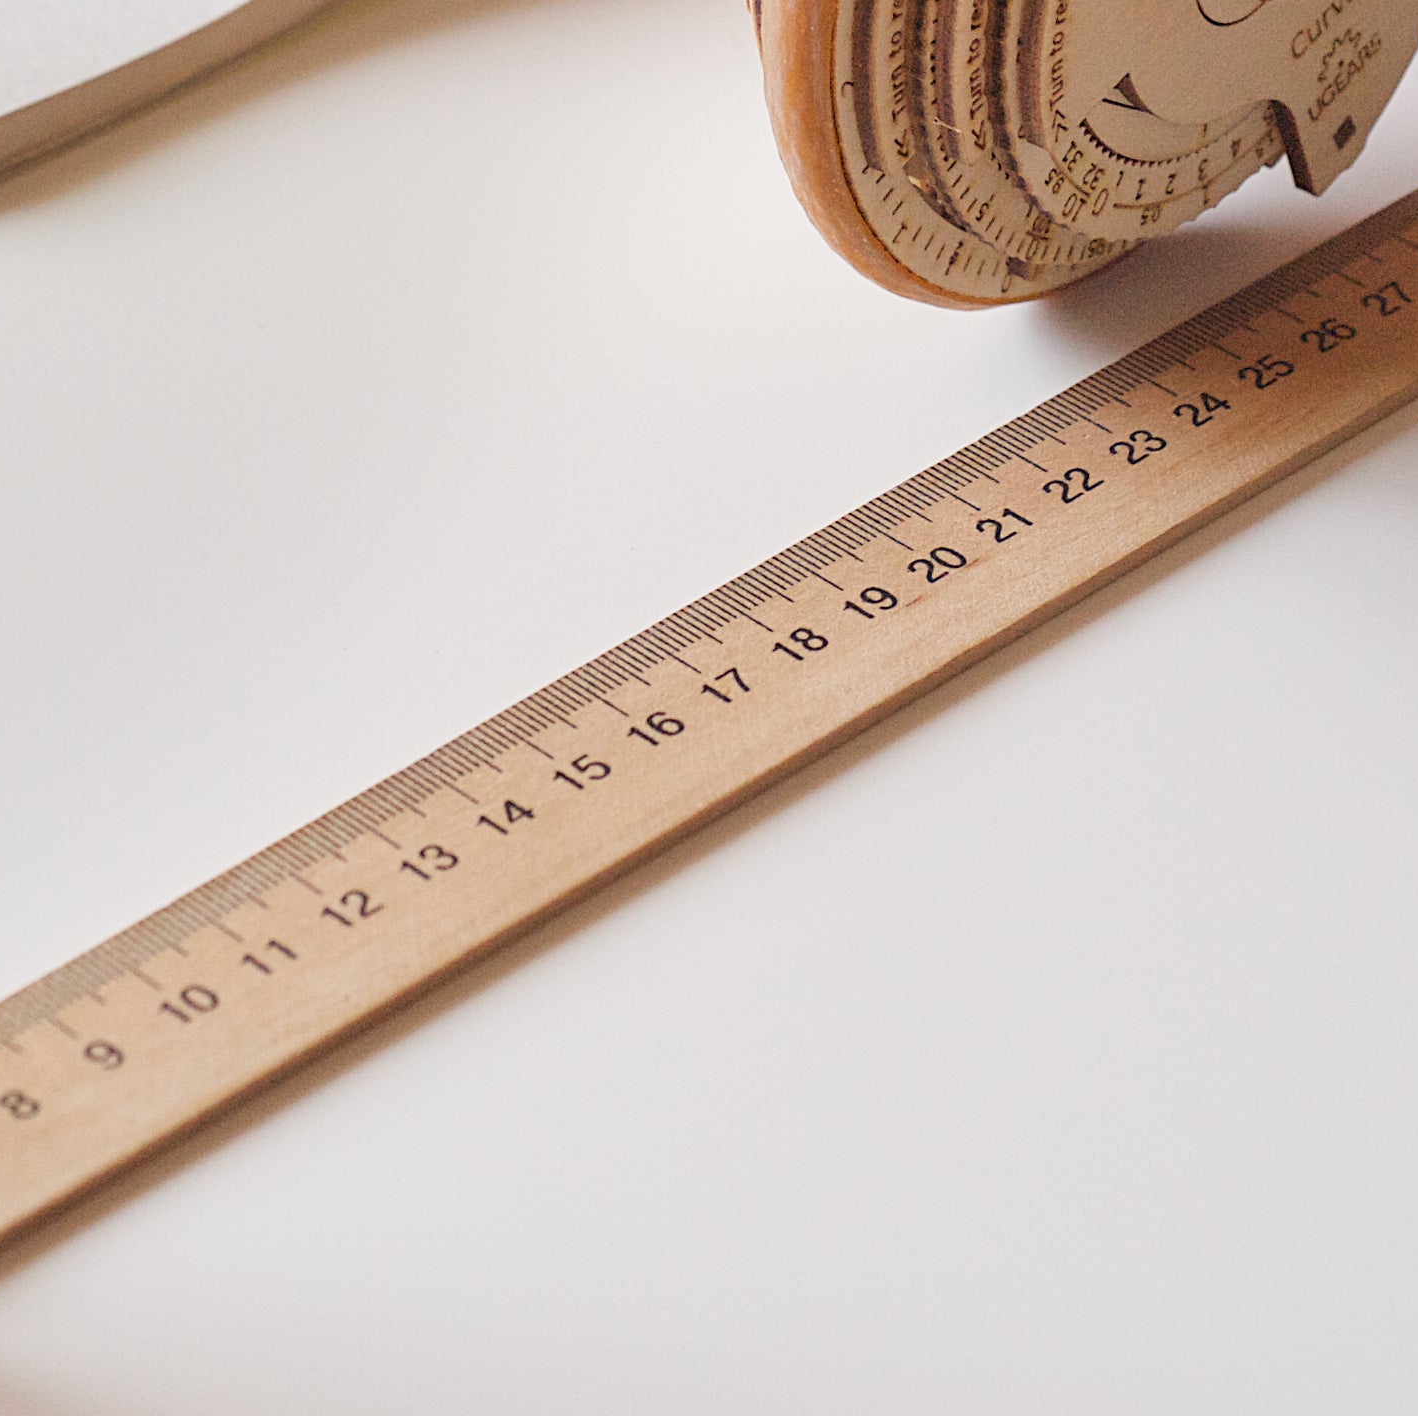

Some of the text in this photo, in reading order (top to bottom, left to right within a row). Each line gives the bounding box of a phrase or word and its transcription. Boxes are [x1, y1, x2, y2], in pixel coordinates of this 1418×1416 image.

[889, 30, 902, 59] to
[966, 37, 981, 65] to
[1049, 31, 1065, 57] to
[891, 64, 907, 123] Turn
[969, 67, 984, 121] Turn
[1049, 58, 1065, 112] Turn
[1307, 38, 1383, 122] UGEARS
[1061, 140, 1084, 173] 31
[1082, 162, 1106, 191] 32
[1165, 172, 1178, 195] 2
[1062, 192, 1087, 223] 10
[84, 1040, 124, 1070] 9
[160, 984, 219, 1023] 10
[242, 938, 297, 975] 11
[320, 890, 383, 928] 12
[401, 844, 460, 880] 13
[478, 799, 536, 835] 14
[554, 755, 611, 790] 15
[628, 712, 684, 746] 16
[701, 668, 752, 703] 17
[773, 628, 829, 661] 18
[844, 587, 898, 620] 19
[908, 546, 967, 582] 20
[975, 508, 1034, 543] 21
[1043, 468, 1104, 503] 22
[1110, 430, 1167, 465] 23
[1173, 393, 1231, 427] 24
[1238, 356, 1296, 389] 25
[1299, 318, 1357, 352] 26
[1361, 282, 1413, 317] 27
